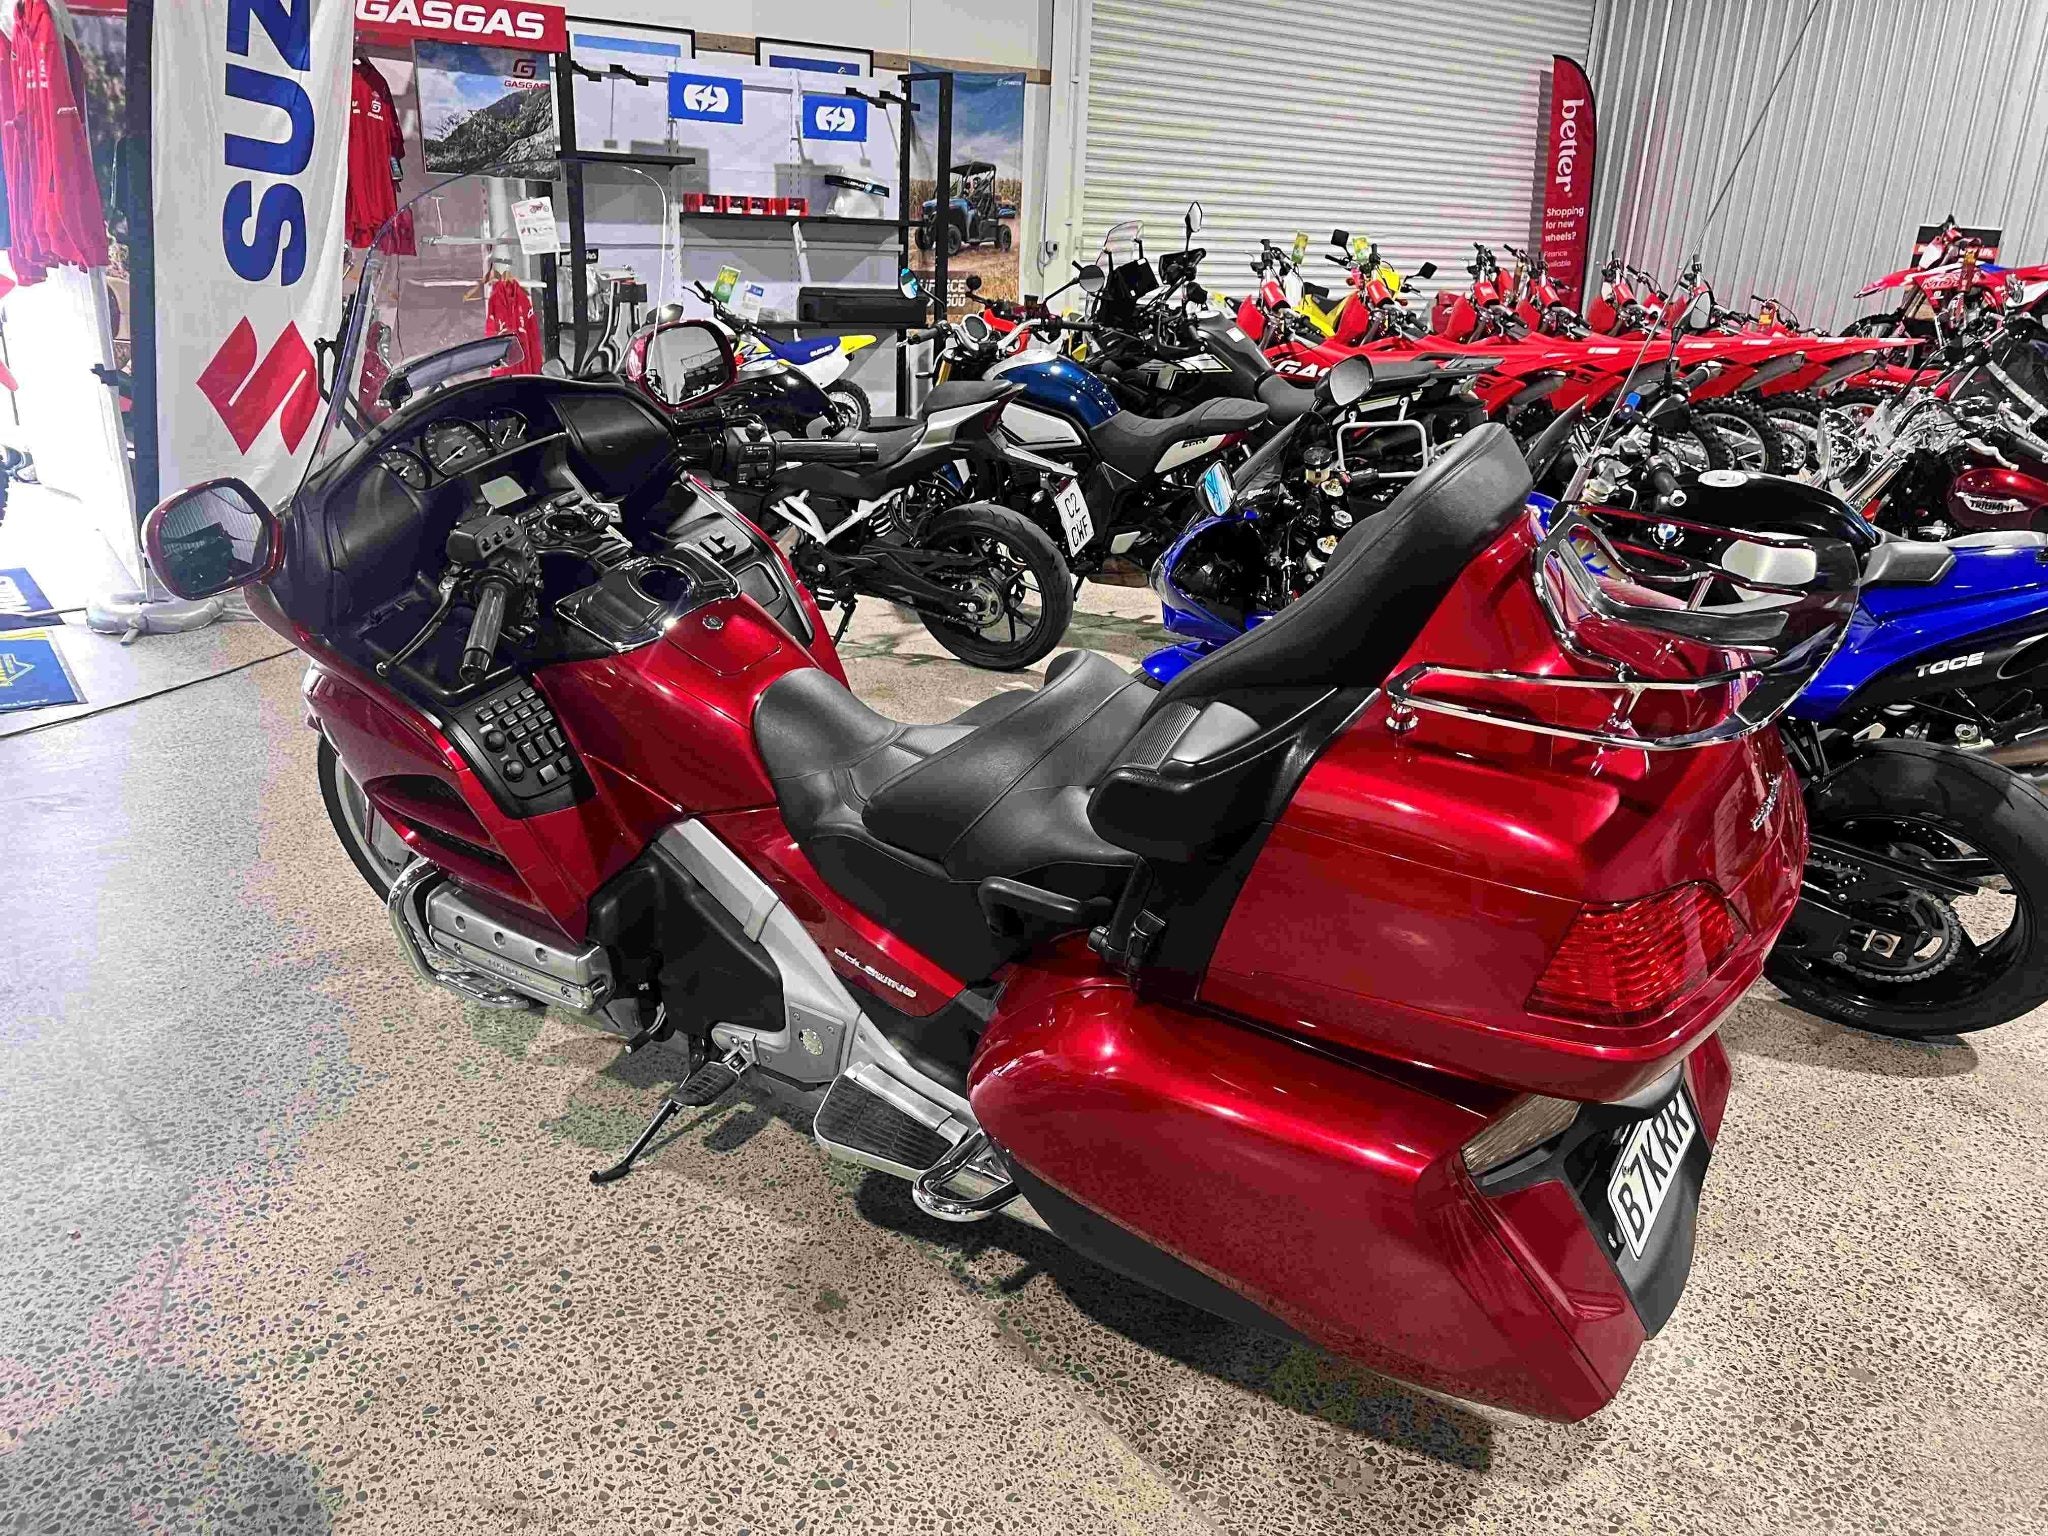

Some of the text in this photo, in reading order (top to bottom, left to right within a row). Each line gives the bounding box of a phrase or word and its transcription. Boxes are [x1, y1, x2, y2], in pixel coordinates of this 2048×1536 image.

[355, 0, 545, 40] GASGAS
[504, 80, 549, 89] GASGAS
[1555, 98, 1584, 193] better
[1545, 220, 1575, 230] for new
[1546, 206, 1585, 218] Shopping
[1545, 232, 1577, 242] wheels?
[1065, 492, 1080, 518] C2
[1969, 499, 2015, 512] TRIUMPH
[1071, 514, 1088, 547] CWF
[1915, 651, 1985, 678] TOCE
[1617, 1099, 1690, 1243] B7KRR
